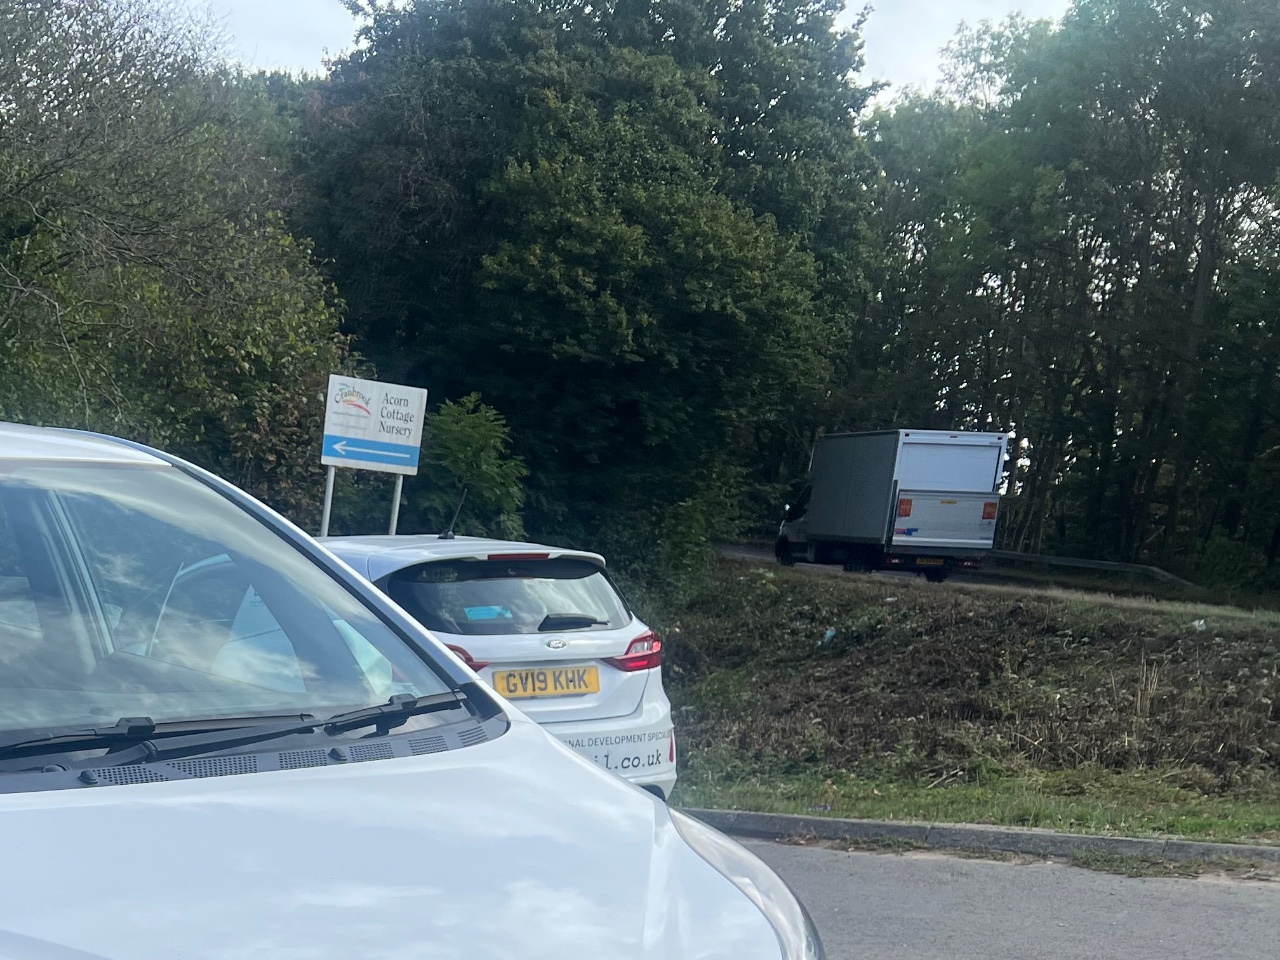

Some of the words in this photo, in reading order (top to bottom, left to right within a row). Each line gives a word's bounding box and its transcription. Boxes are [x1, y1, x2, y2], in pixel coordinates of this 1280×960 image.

[334, 386, 371, 407] Cranbrook
[382, 392, 409, 408] Acorn
[380, 406, 415, 424] Cottage
[379, 420, 413, 438] Nursery
[505, 671, 548, 693] GV19
[552, 669, 589, 691] KHK
[563, 739, 585, 748] NAL
[588, 732, 646, 747] DEVELOPMENT
